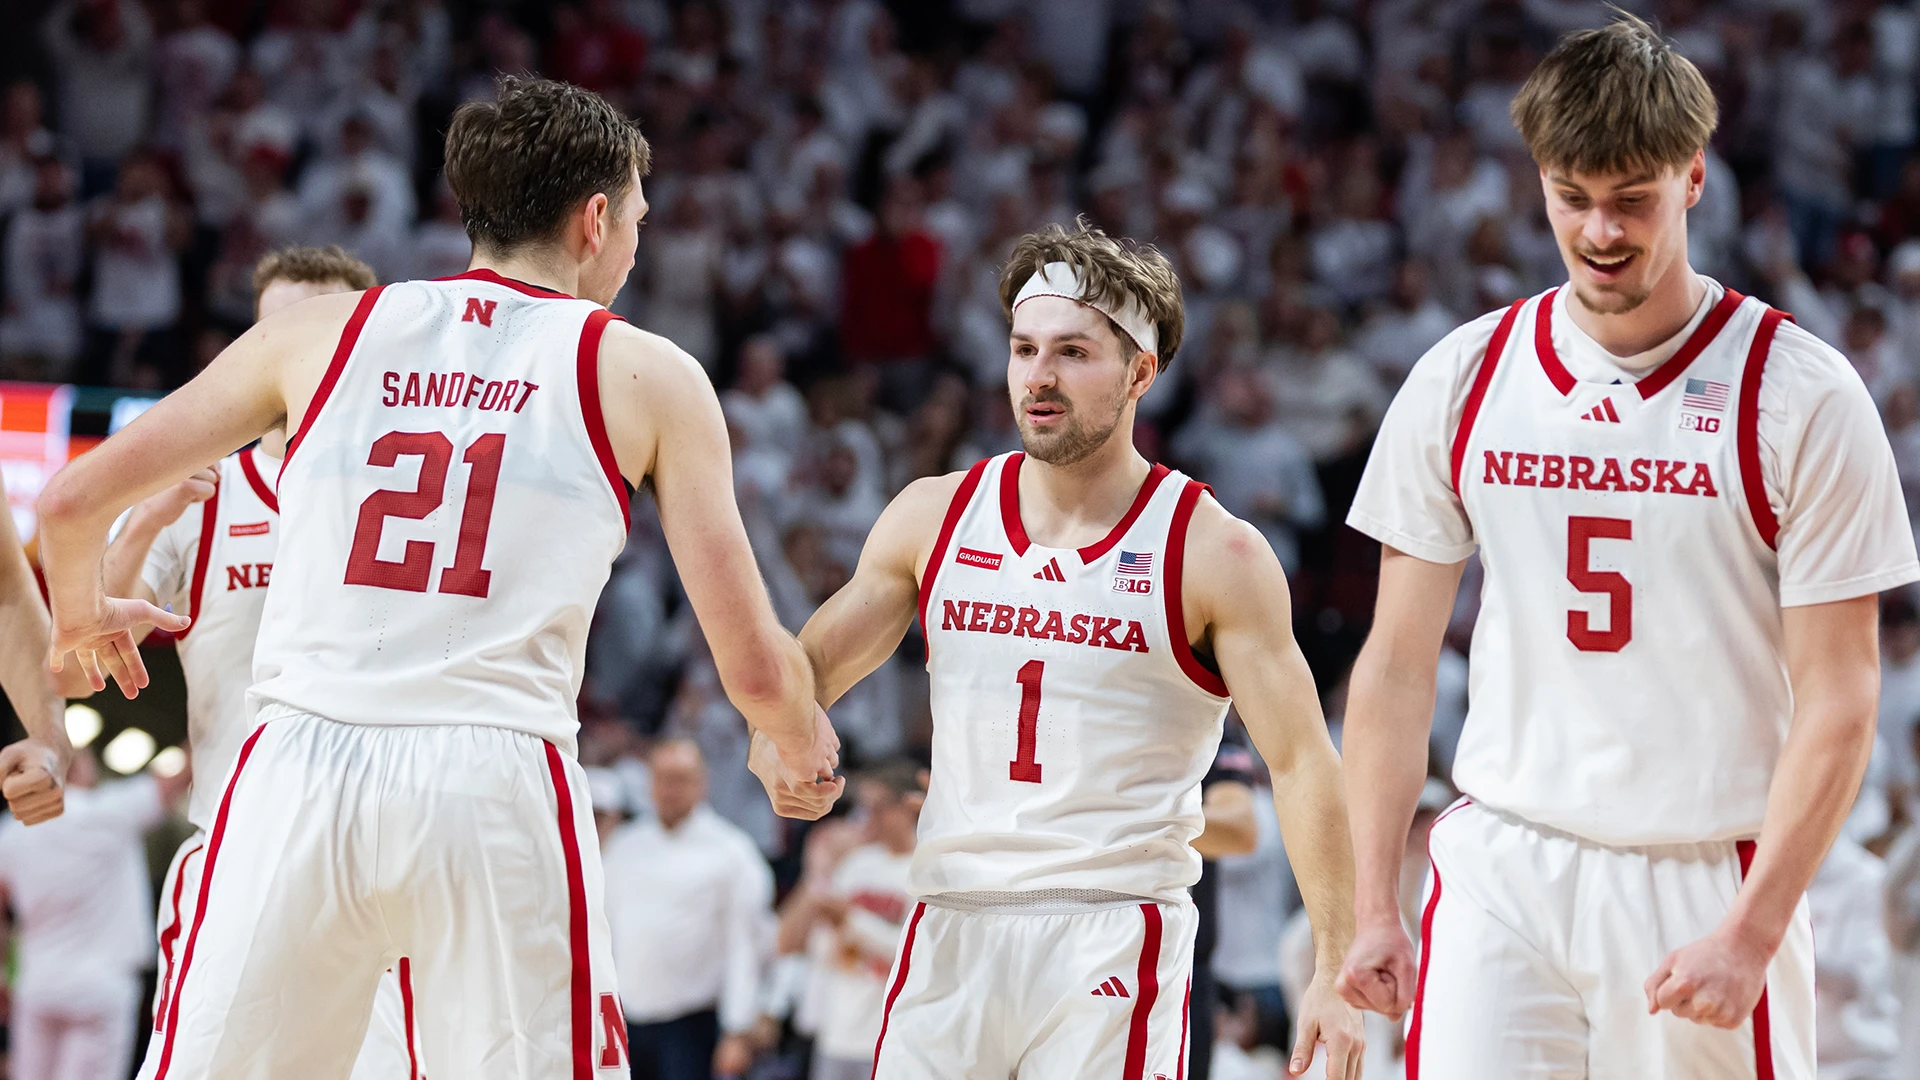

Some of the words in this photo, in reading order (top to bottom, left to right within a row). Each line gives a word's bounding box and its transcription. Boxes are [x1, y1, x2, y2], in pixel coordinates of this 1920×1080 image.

[461, 297, 499, 328] N
[382, 371, 539, 414] SANDFORT
[1483, 450, 1718, 497] NEBRASKA
[343, 430, 506, 598] 21
[958, 551, 1000, 567] GRADUATE
[1566, 515, 1632, 652] 5
[942, 599, 1150, 653] NEBRASKA
[1009, 659, 1045, 784] 1
[599, 991, 630, 1069] N
